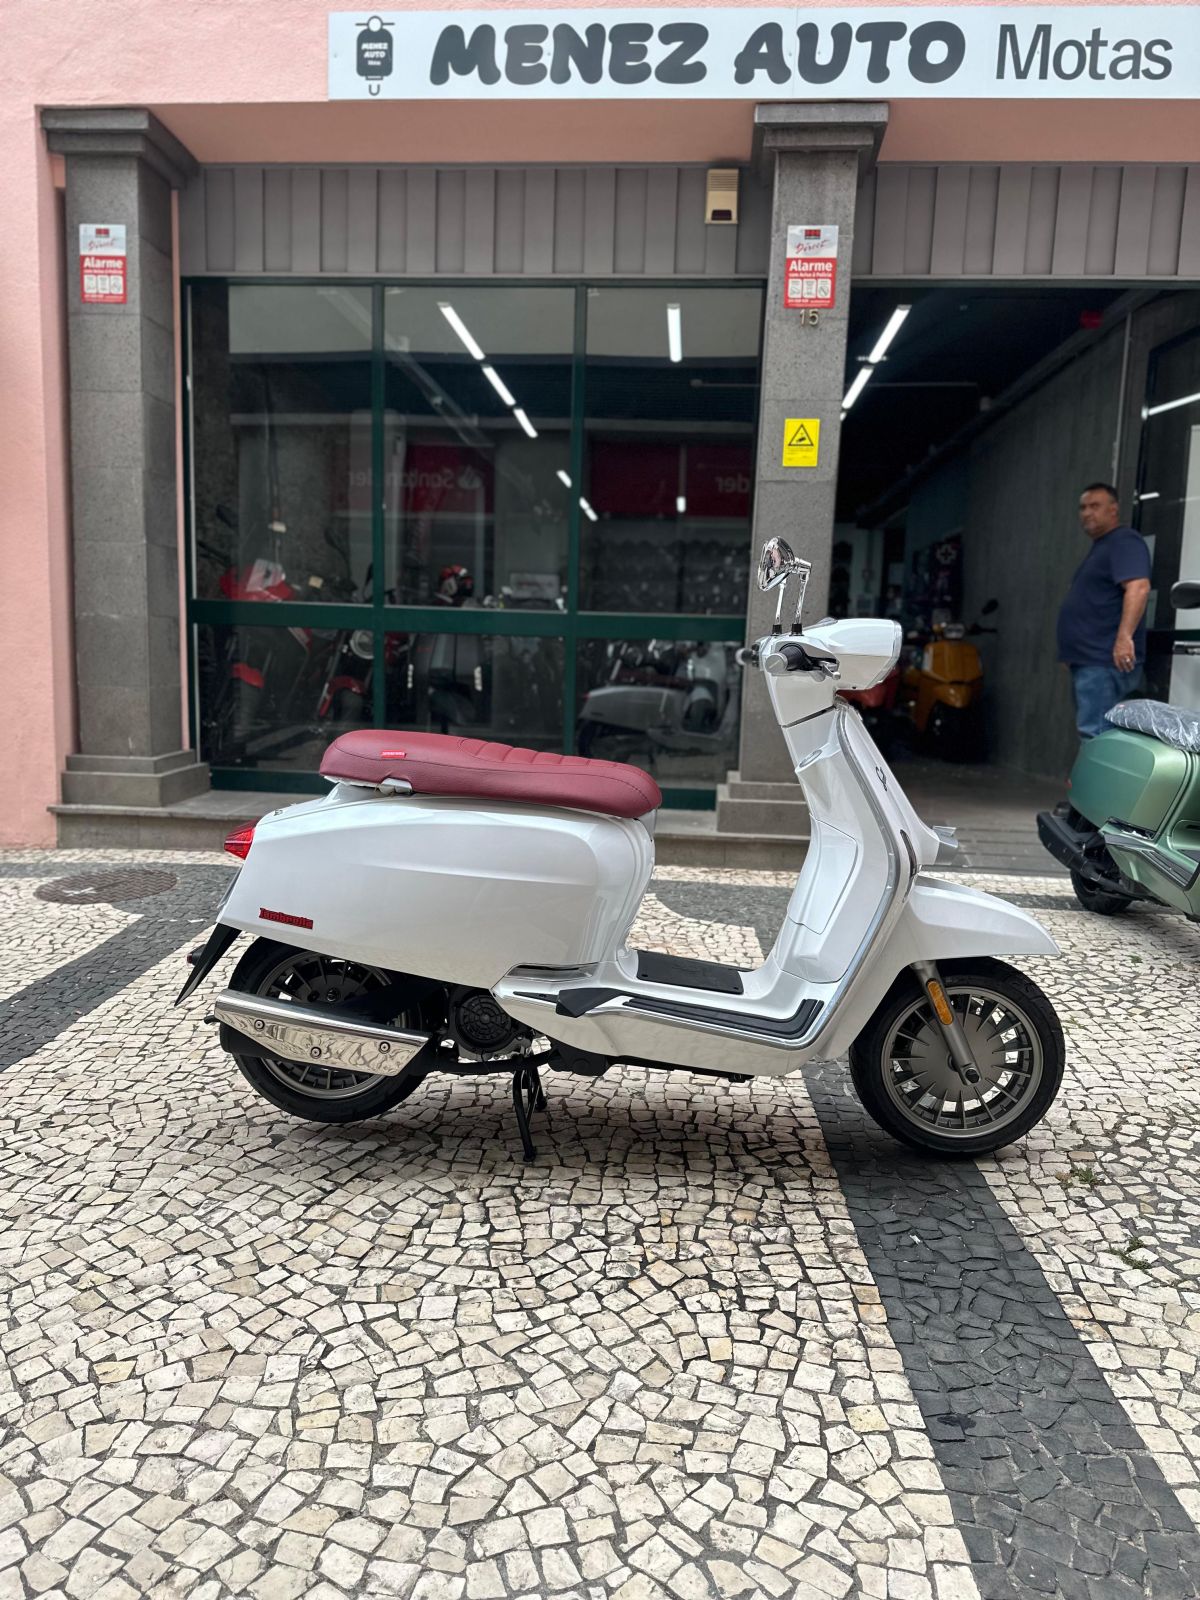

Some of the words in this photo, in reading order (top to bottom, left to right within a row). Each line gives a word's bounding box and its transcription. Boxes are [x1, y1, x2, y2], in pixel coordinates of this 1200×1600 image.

[363, 51, 386, 59] AUTO
[429, 22, 709, 86] MENEZ
[733, 20, 966, 85] AUTO
[996, 23, 1173, 81] Motas
[84, 258, 123, 269] Alarme
[789, 259, 832, 272] Alarme
[799, 308, 819, 326] 15
